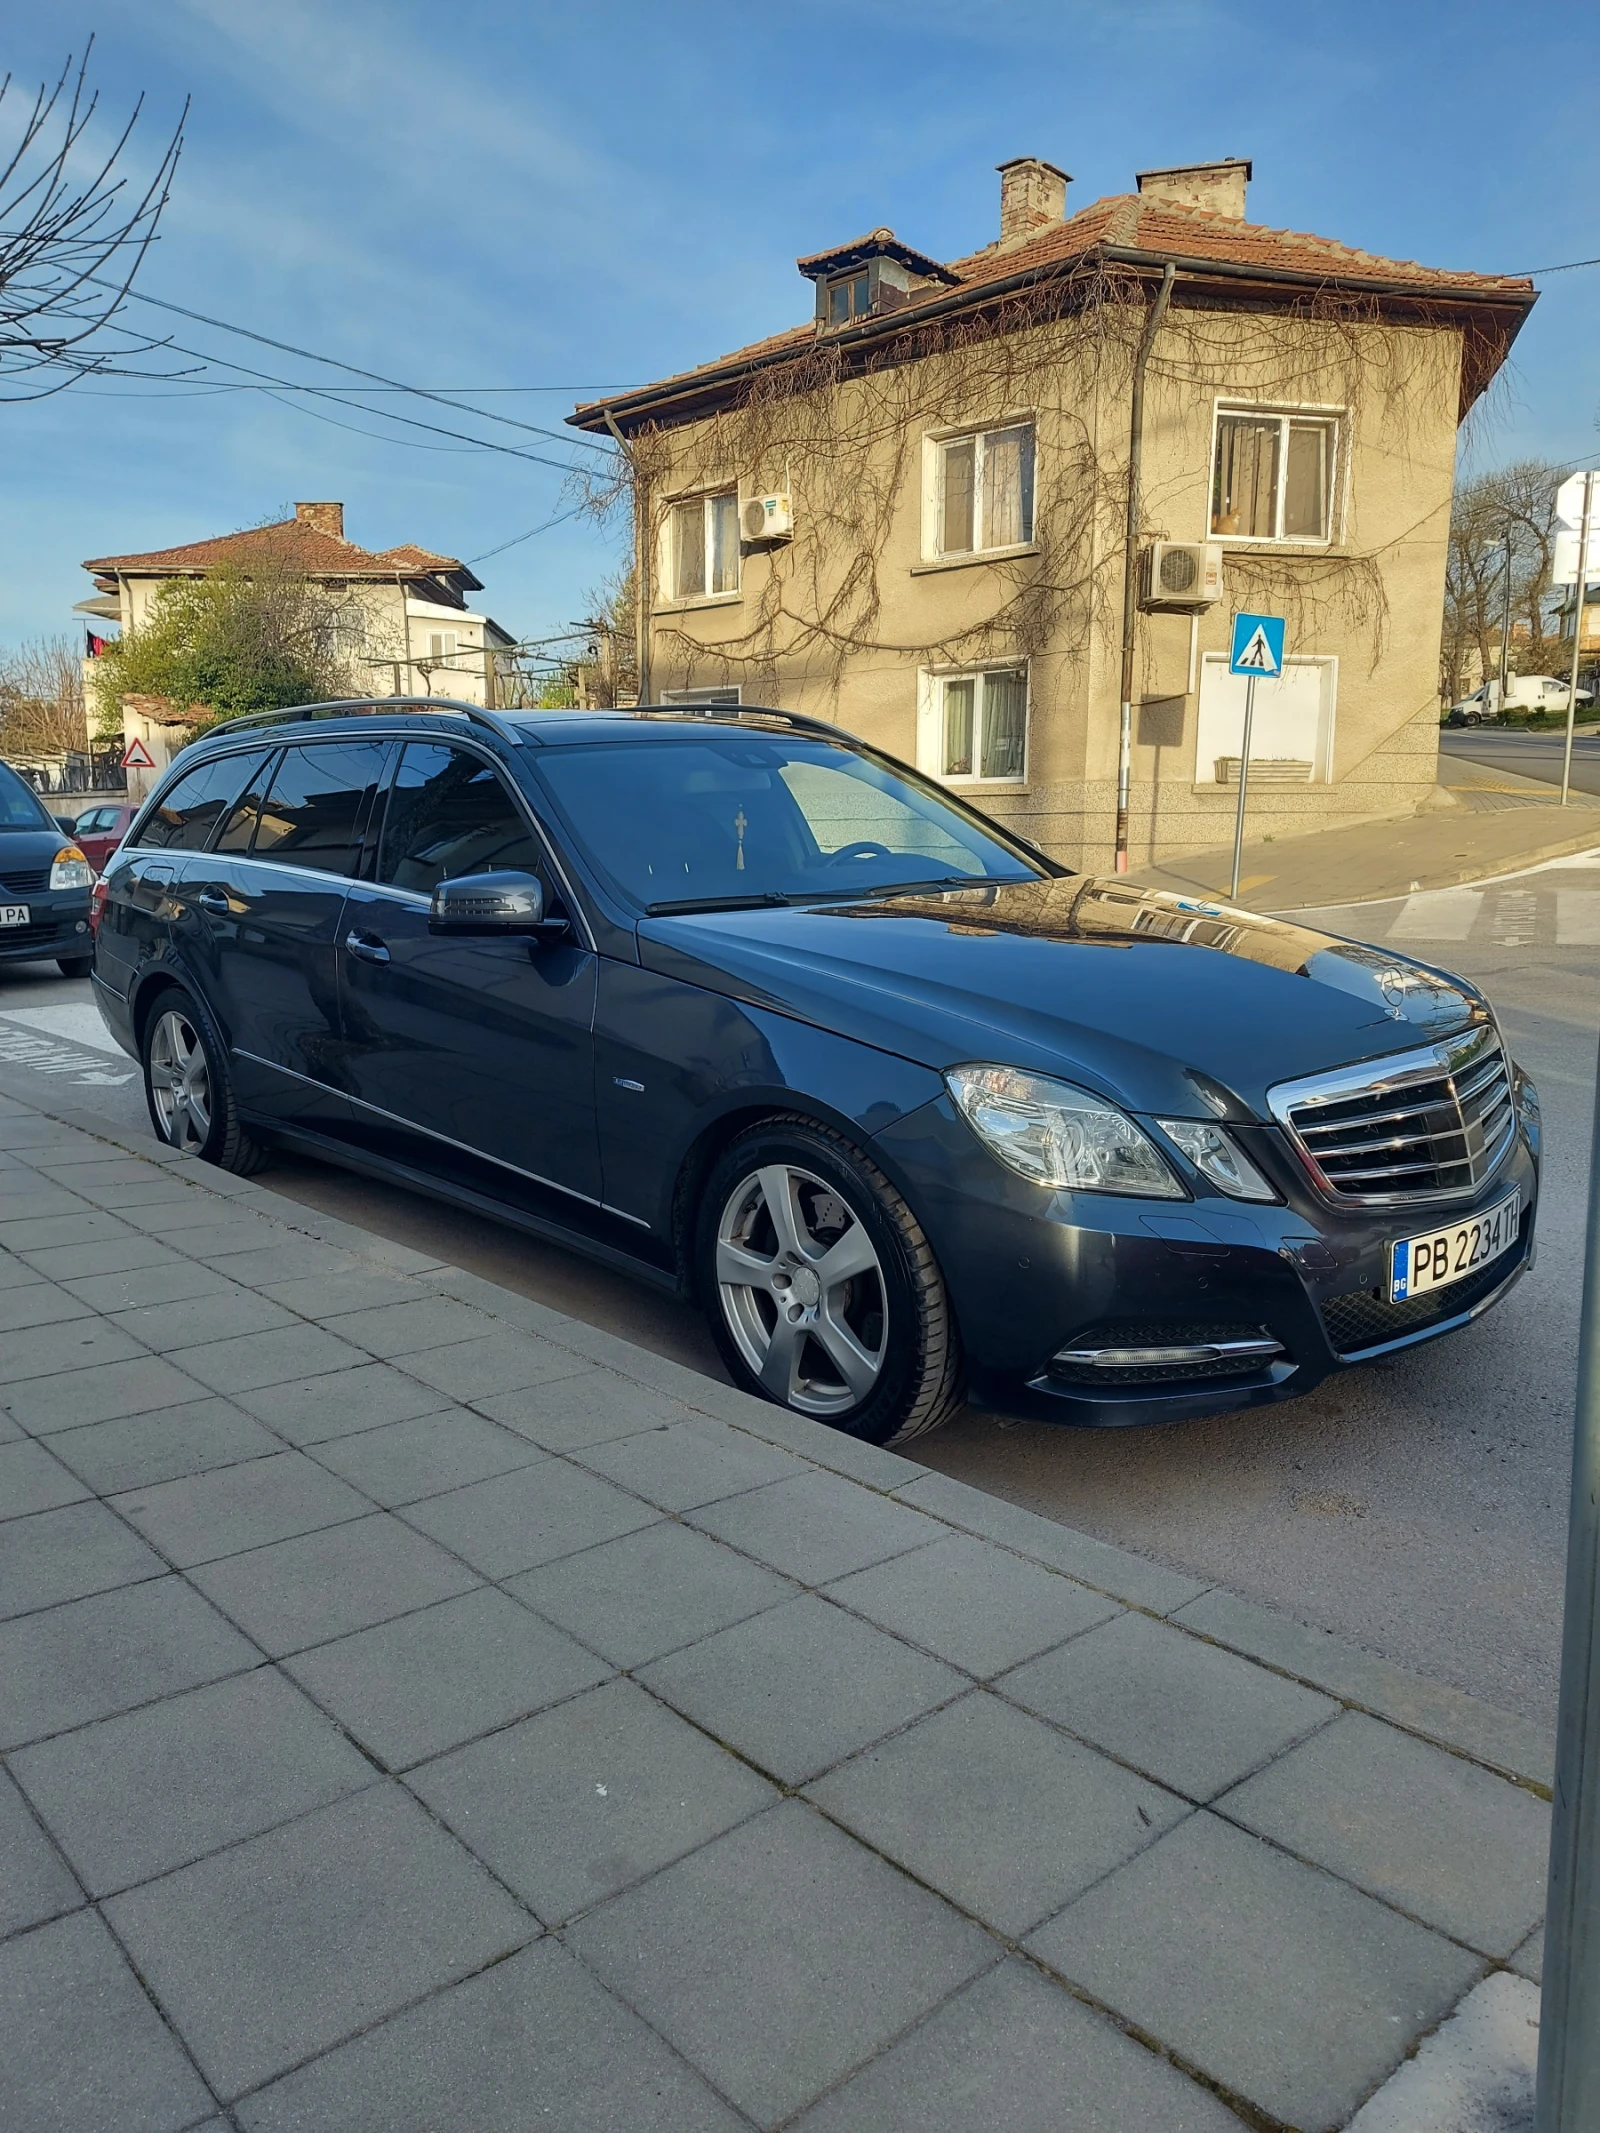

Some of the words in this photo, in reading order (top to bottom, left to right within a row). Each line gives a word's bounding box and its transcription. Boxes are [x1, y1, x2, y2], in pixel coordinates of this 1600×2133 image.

[6, 908, 26, 922] PA
[1413, 1236, 1449, 1288] PB
[1454, 1210, 1501, 1274] 2234
[1503, 1194, 1519, 1245] TH
[1394, 1277, 1407, 1292] BG
